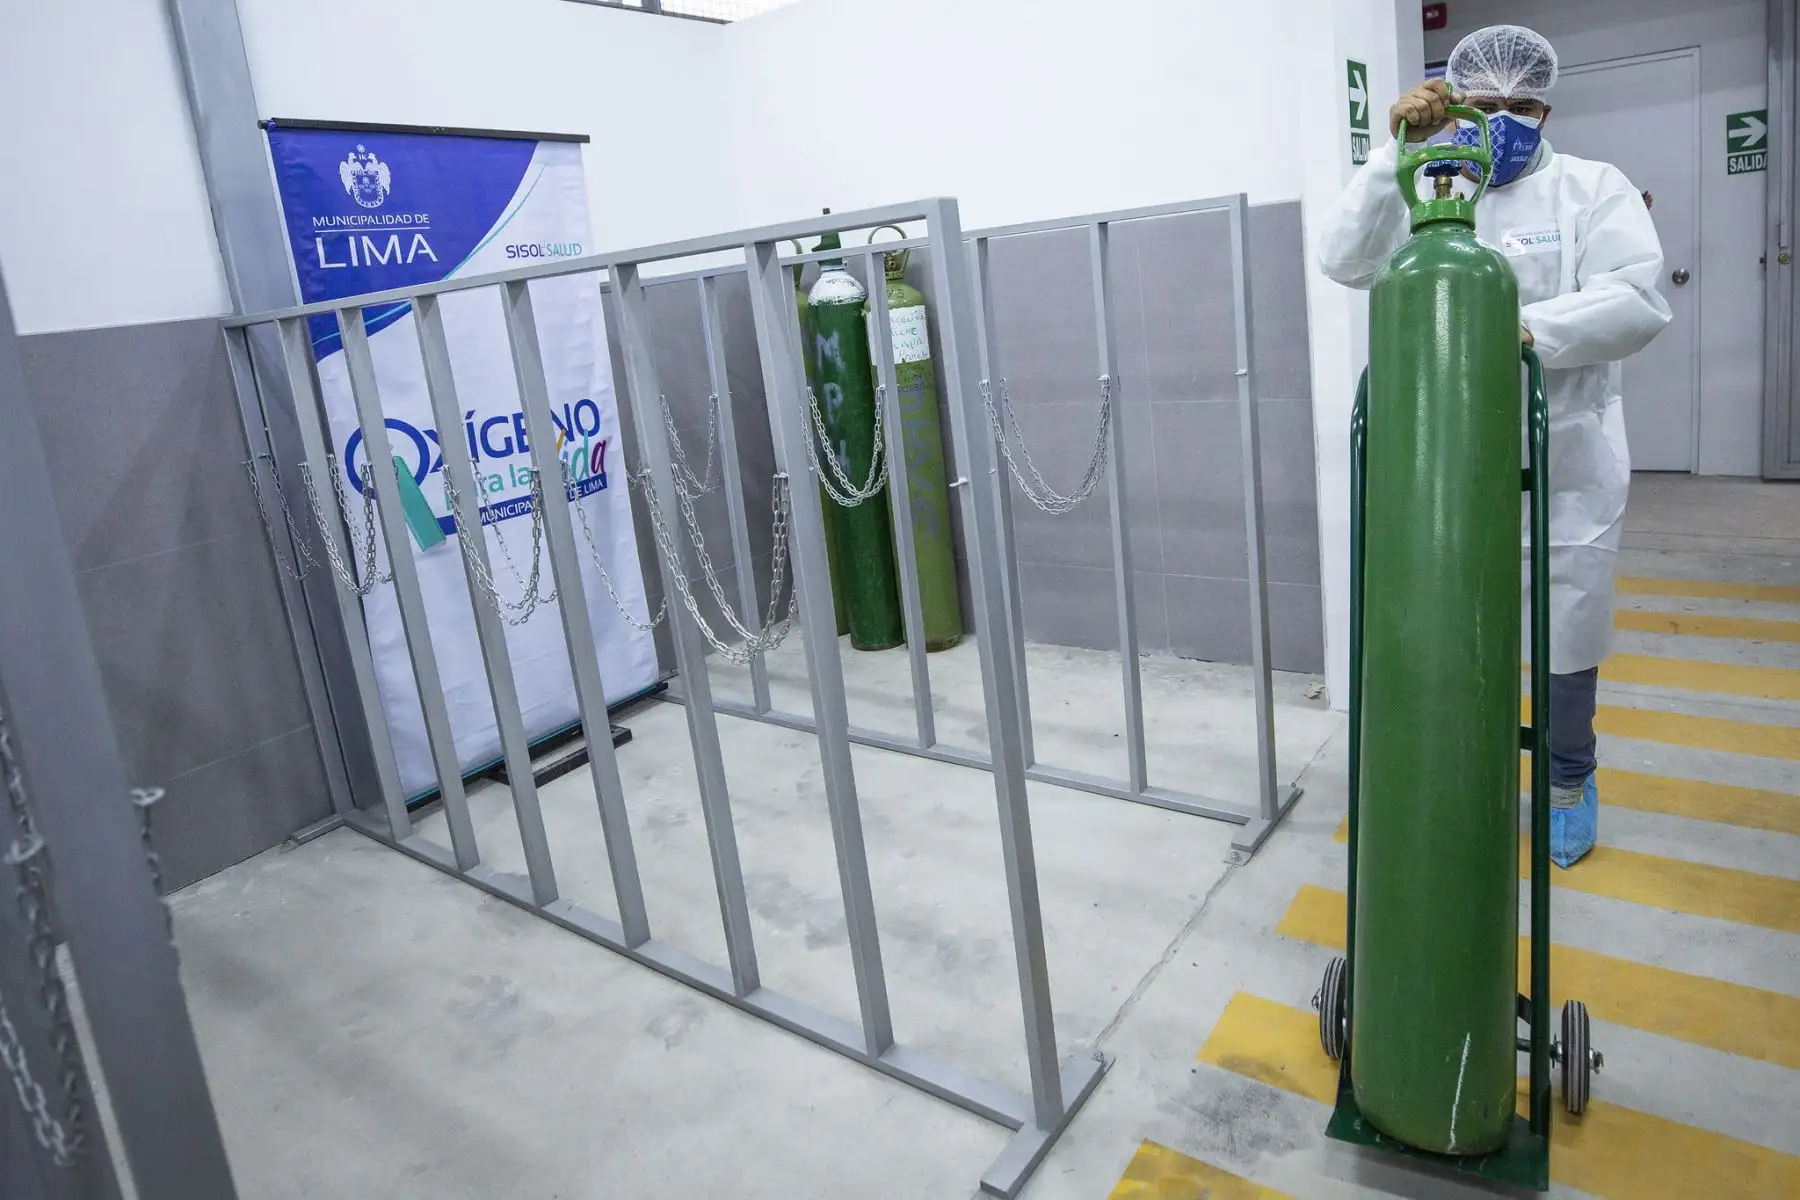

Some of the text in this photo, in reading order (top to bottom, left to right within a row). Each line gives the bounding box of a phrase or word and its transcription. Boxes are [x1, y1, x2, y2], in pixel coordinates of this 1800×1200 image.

[313, 213, 430, 227] MUNICIPALIDAD DE
[316, 233, 438, 268] LIMA
[505, 242, 582, 258] SISOL SALUD
[508, 464, 533, 489] la
[583, 479, 604, 495] LIMA
